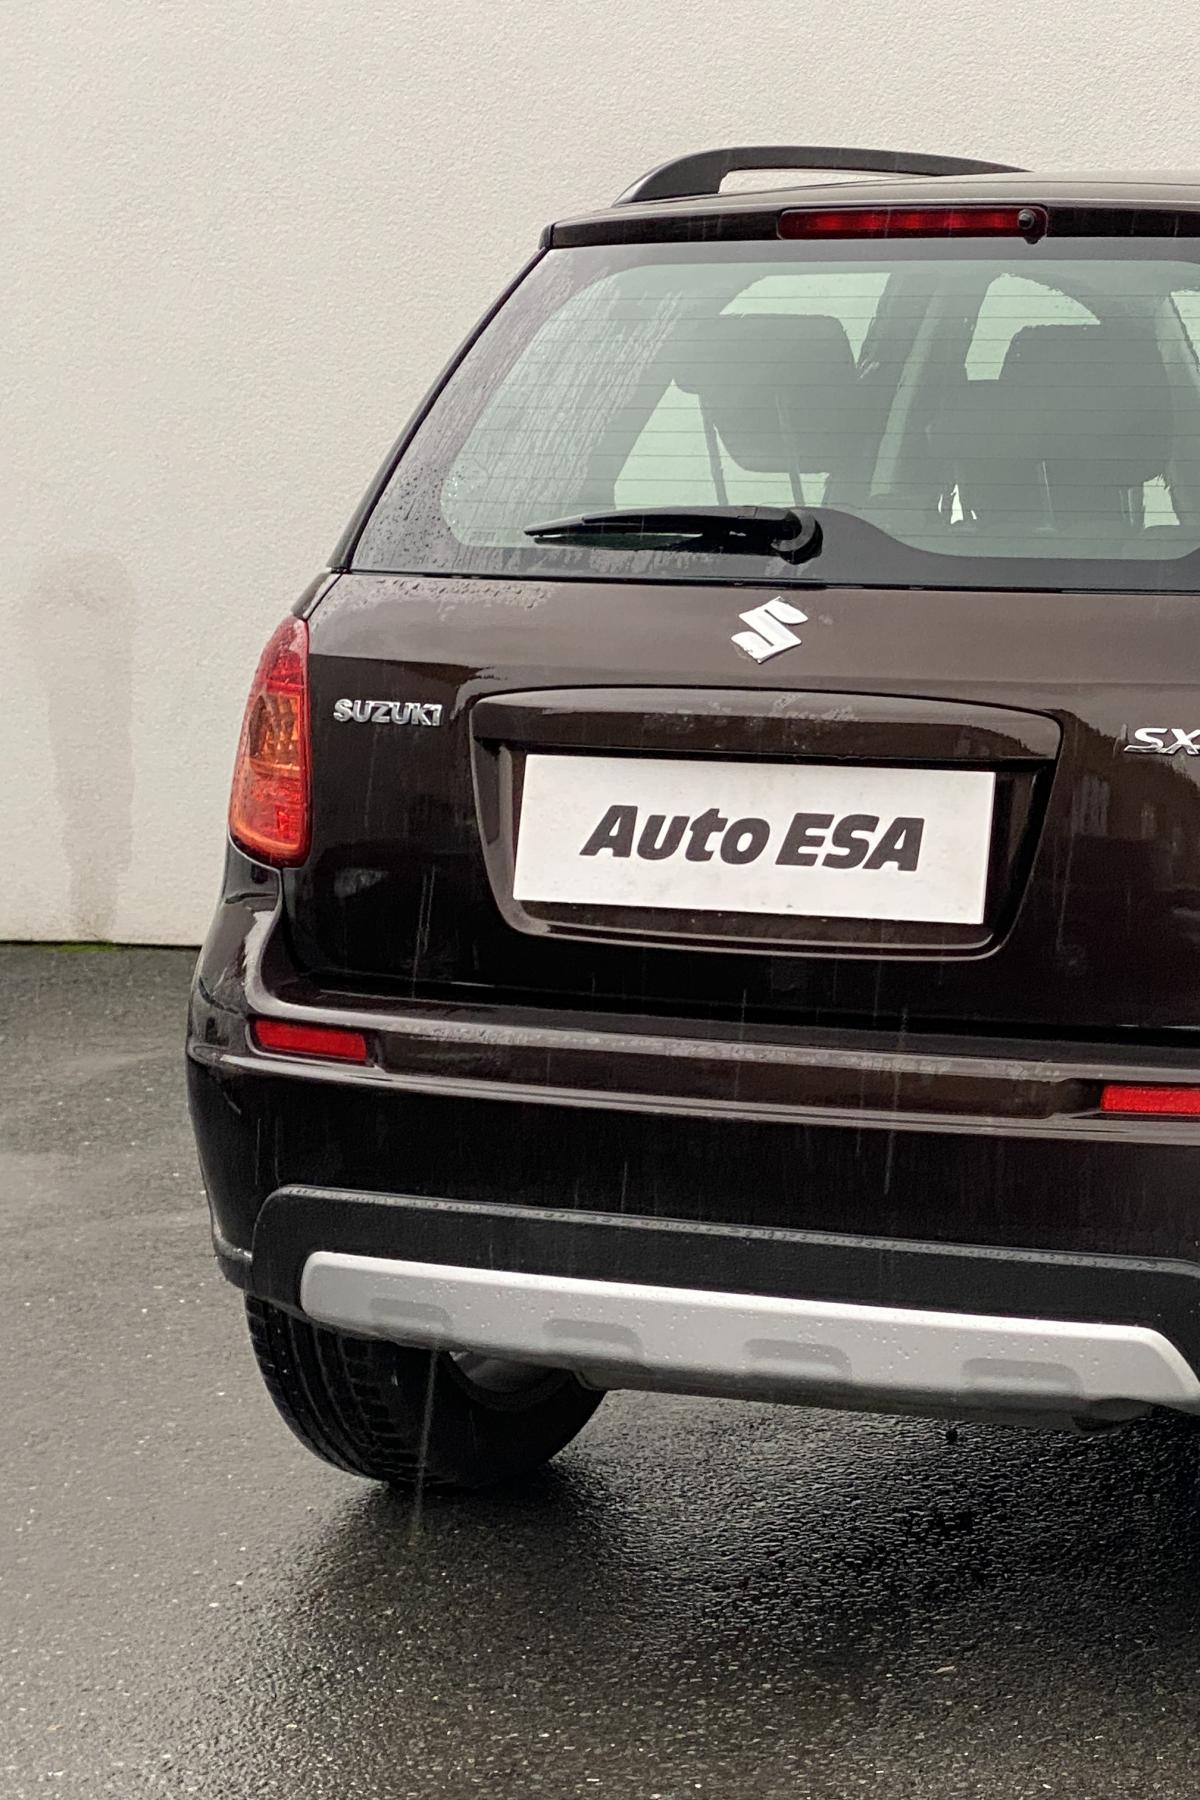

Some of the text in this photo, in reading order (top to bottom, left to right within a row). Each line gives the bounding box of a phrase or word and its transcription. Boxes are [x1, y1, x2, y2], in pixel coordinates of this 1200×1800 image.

[332, 698, 443, 726] SUZUKI
[579, 804, 925, 871] Auto ESA
